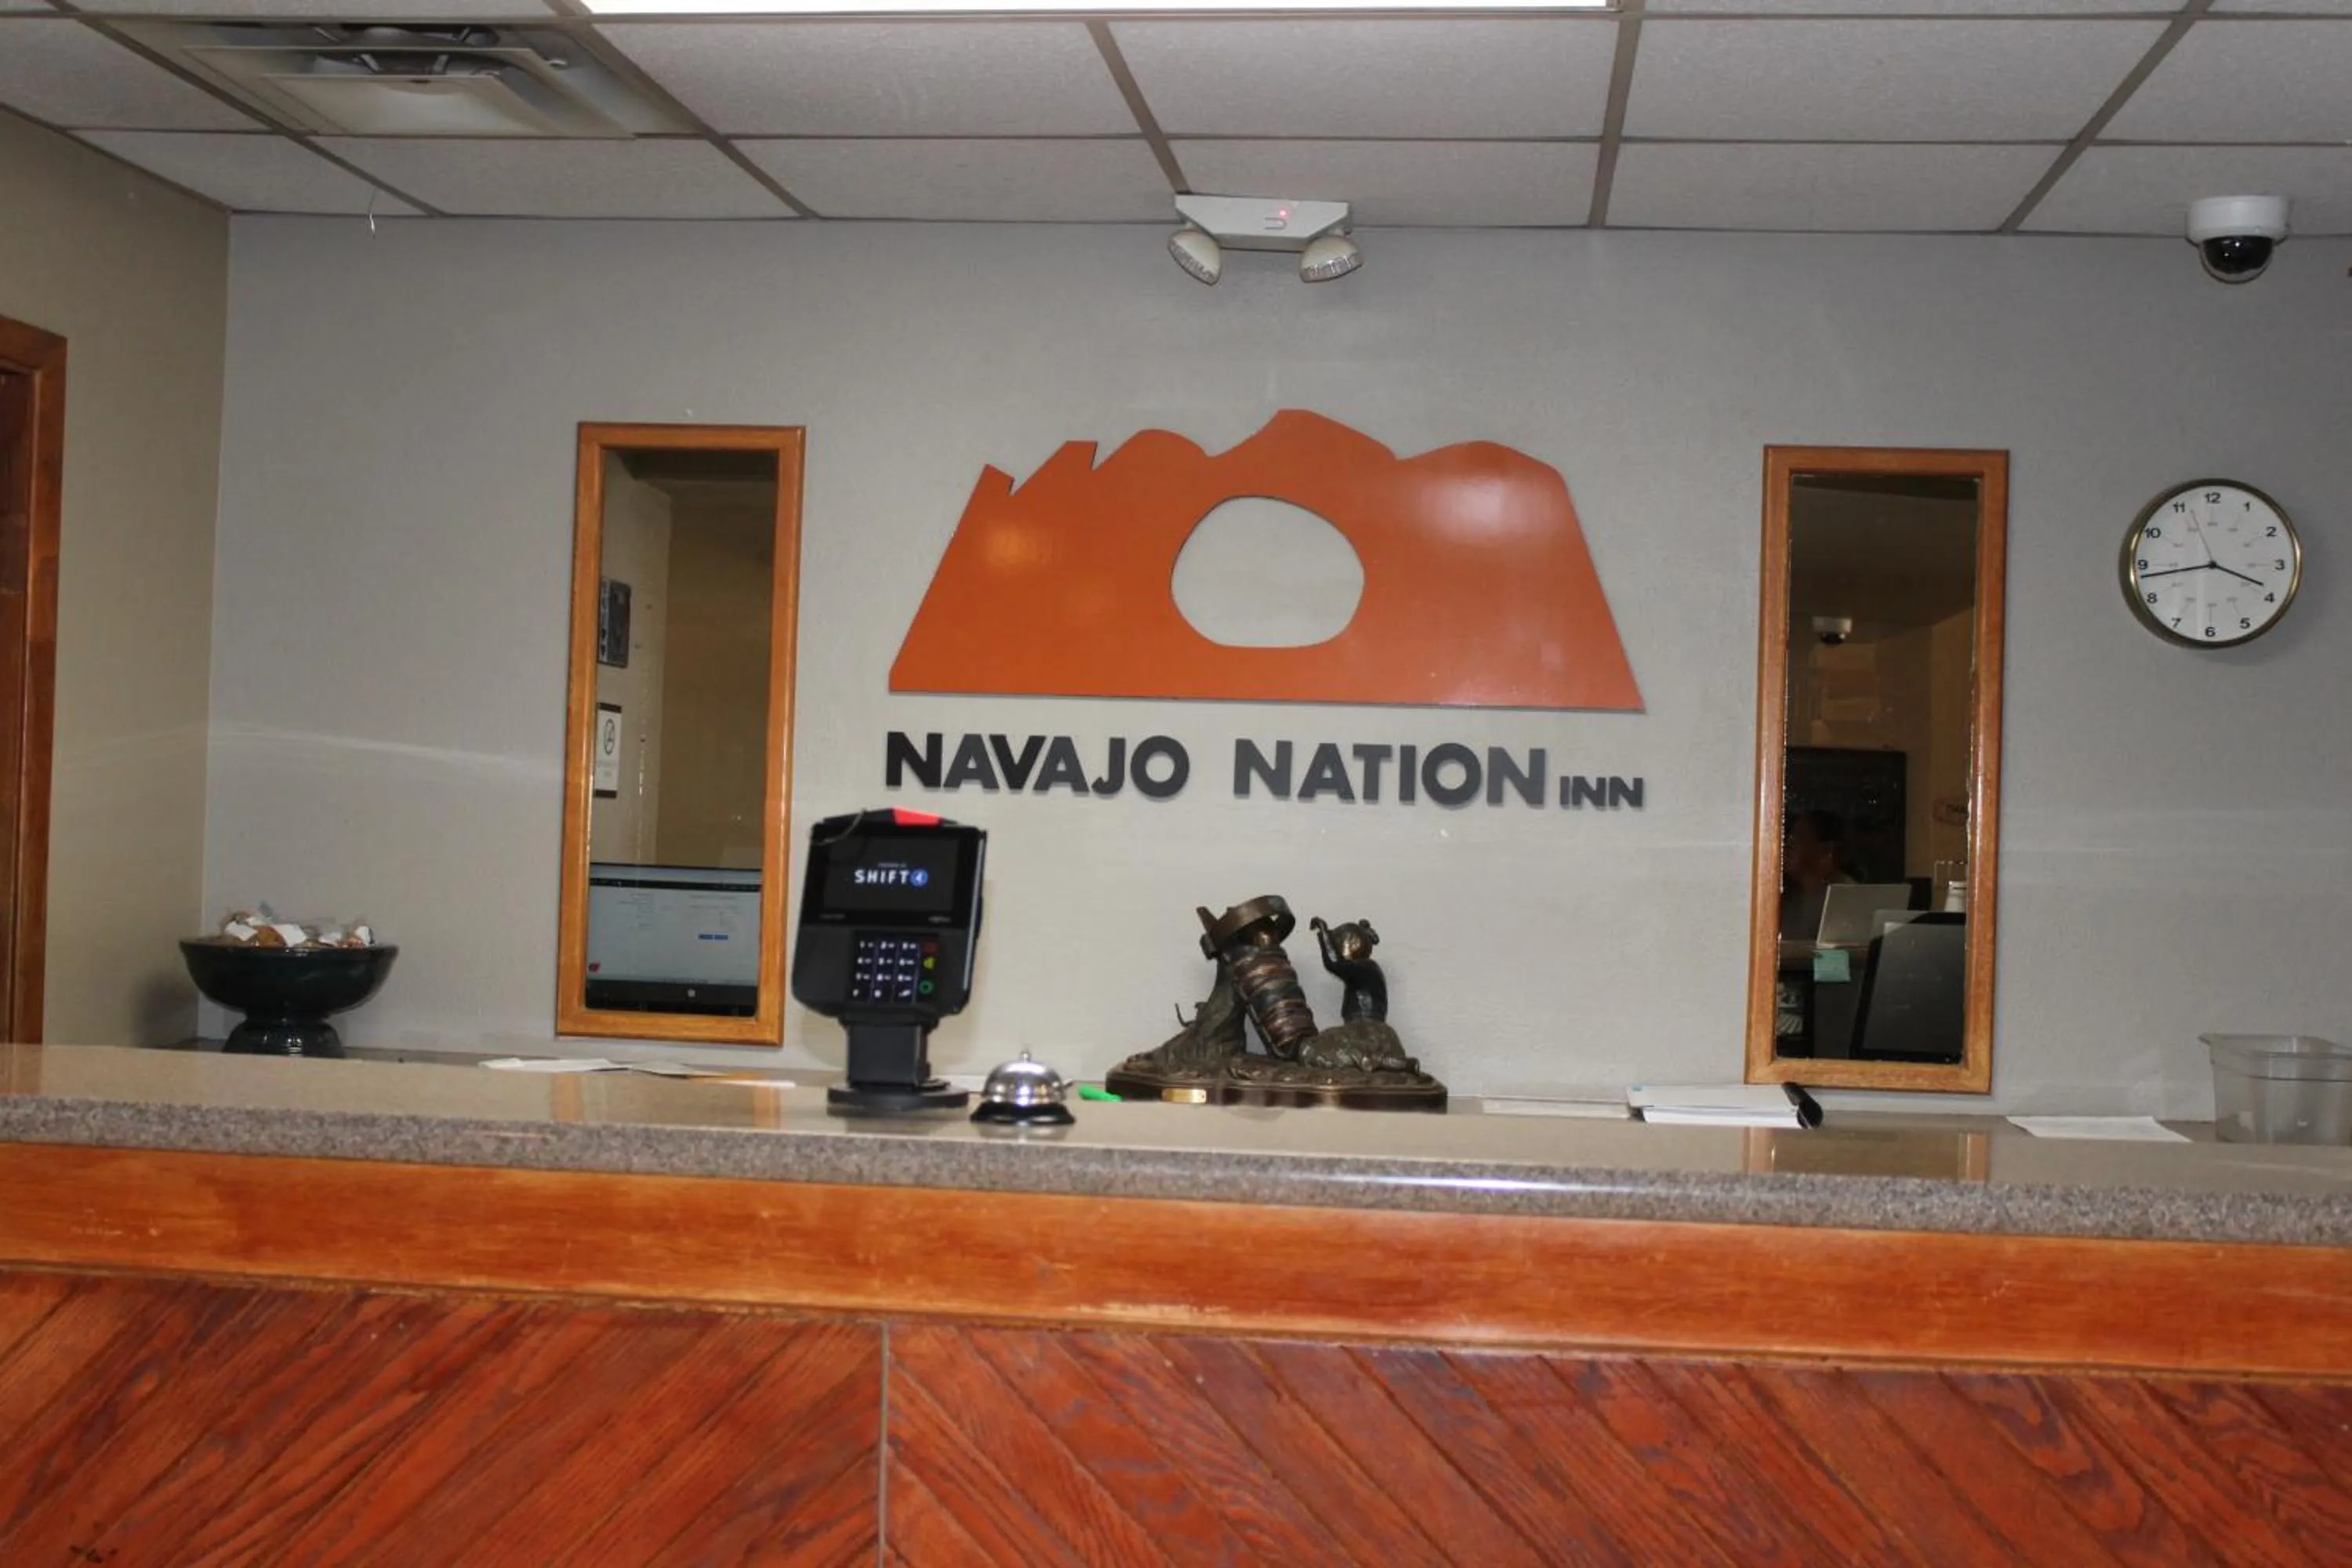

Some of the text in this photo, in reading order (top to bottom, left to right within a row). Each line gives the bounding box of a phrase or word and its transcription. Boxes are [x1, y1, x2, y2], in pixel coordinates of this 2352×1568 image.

[2205, 492, 2220, 504] 12
[2173, 502, 2186, 513] 11
[2244, 502, 2251, 512] 1
[2145, 528, 2161, 539] 10
[2266, 526, 2277, 537] 2
[2137, 559, 2148, 570] 9
[2274, 560, 2285, 571] 3
[2147, 593, 2158, 604] 8
[2264, 592, 2274, 603] 4
[2171, 618, 2181, 628] 7
[2240, 618, 2250, 629] 5
[2205, 626, 2216, 637] 6
[886, 731, 1644, 808] NAVAJO NATION INN
